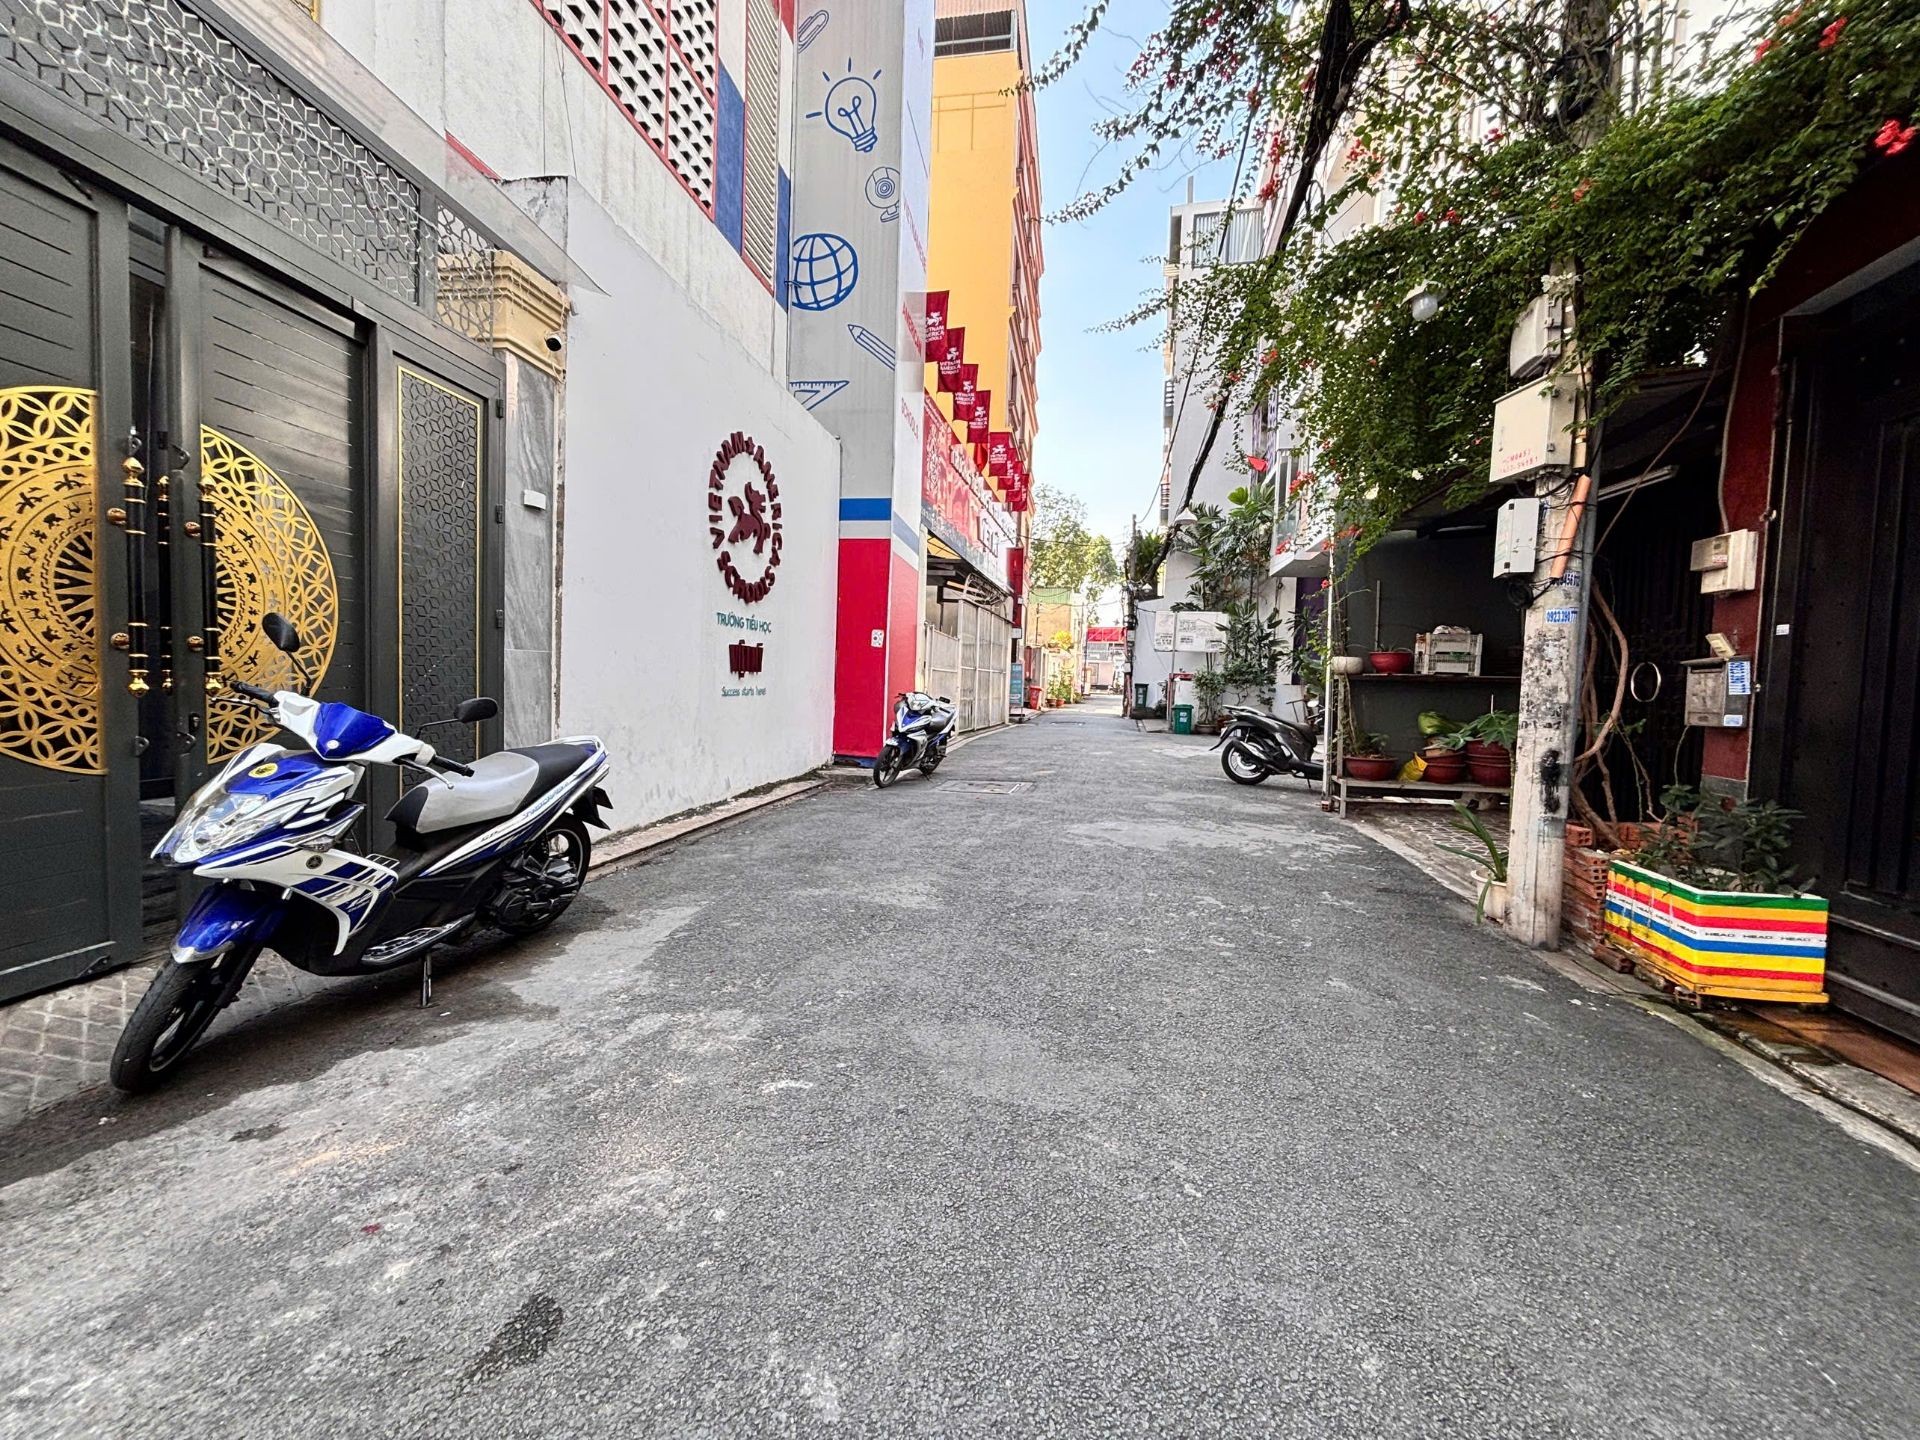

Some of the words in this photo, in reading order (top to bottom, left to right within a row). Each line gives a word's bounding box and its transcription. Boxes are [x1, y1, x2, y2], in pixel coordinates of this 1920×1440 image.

[708, 431, 745, 550] VIETNAM
[753, 446, 782, 566] AMERICA
[717, 551, 775, 604] SCHOOLS
[759, 620, 772, 634] HỌC
